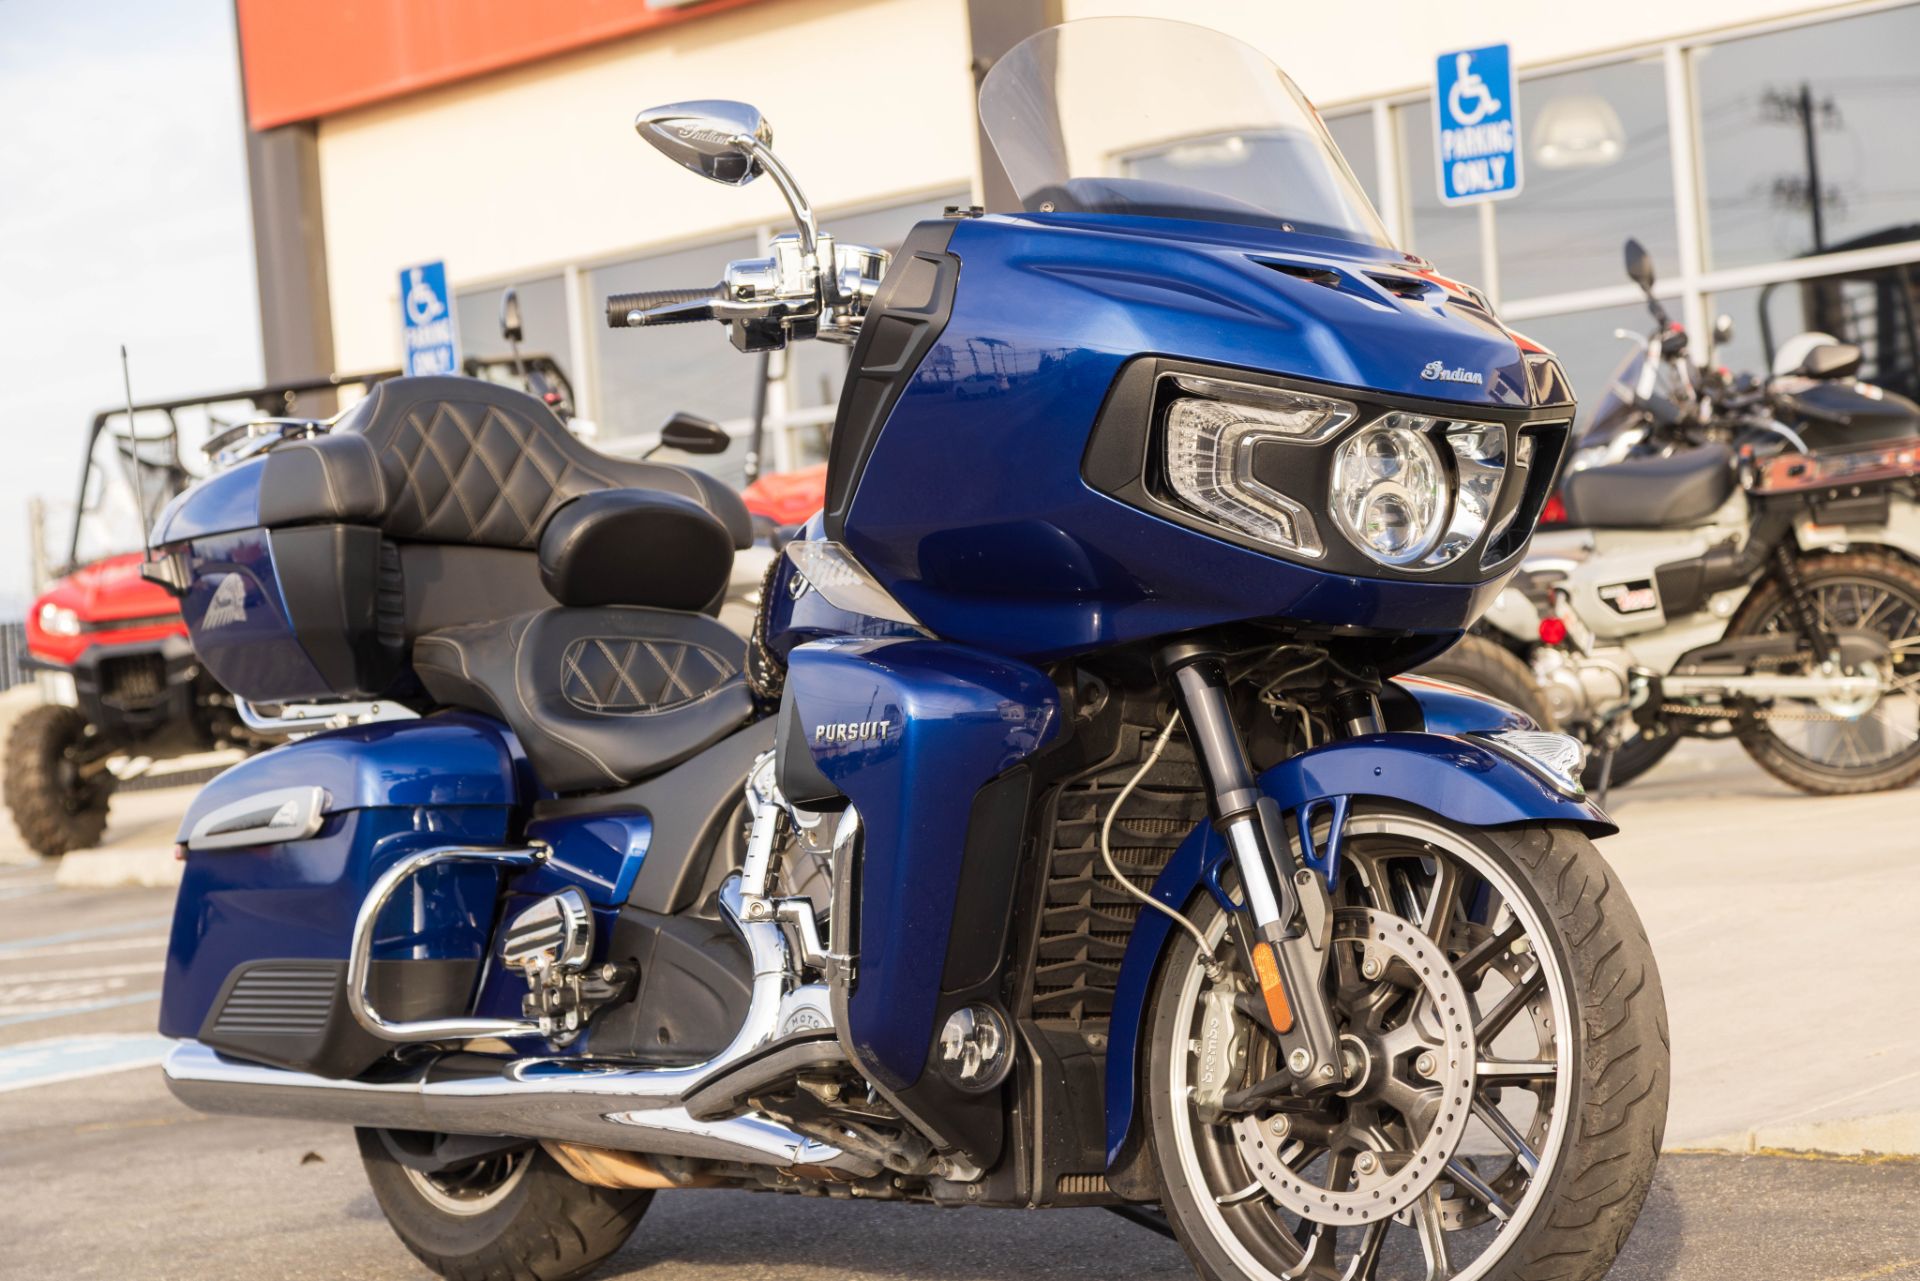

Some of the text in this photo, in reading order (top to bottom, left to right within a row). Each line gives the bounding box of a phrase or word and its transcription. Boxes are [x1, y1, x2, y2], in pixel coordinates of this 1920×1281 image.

[1440, 120, 1513, 163] PARKING
[1452, 156, 1507, 195] ONLY
[1420, 360, 1483, 385] Indian
[815, 720, 891, 743] PURSUIT
[1201, 1018, 1219, 1083] brembo
